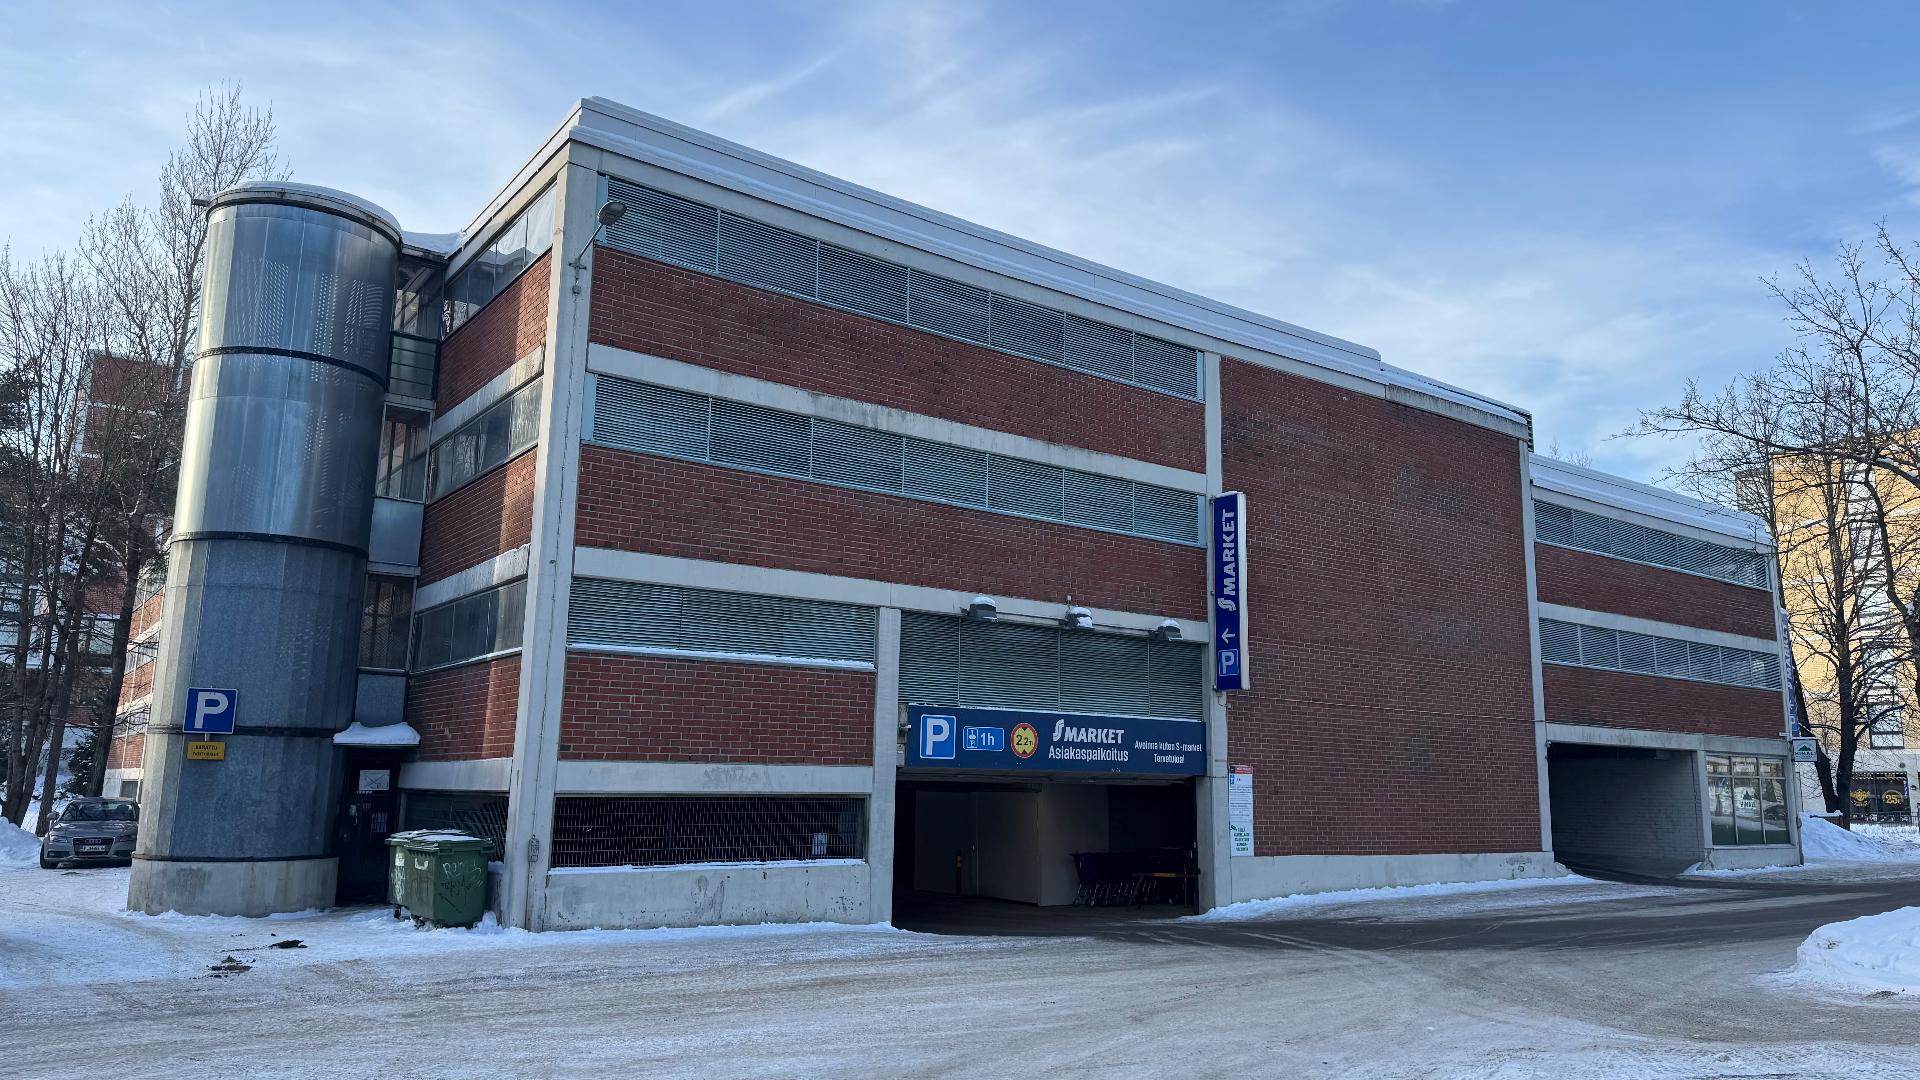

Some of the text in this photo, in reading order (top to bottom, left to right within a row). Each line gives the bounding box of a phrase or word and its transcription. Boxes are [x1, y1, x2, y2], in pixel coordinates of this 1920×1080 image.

[1221, 651, 1235, 674] P
[194, 691, 229, 729] P
[925, 717, 950, 756] P
[980, 732, 995, 746] 1h
[1048, 745, 1129, 763] Asiakaspaikoitus
